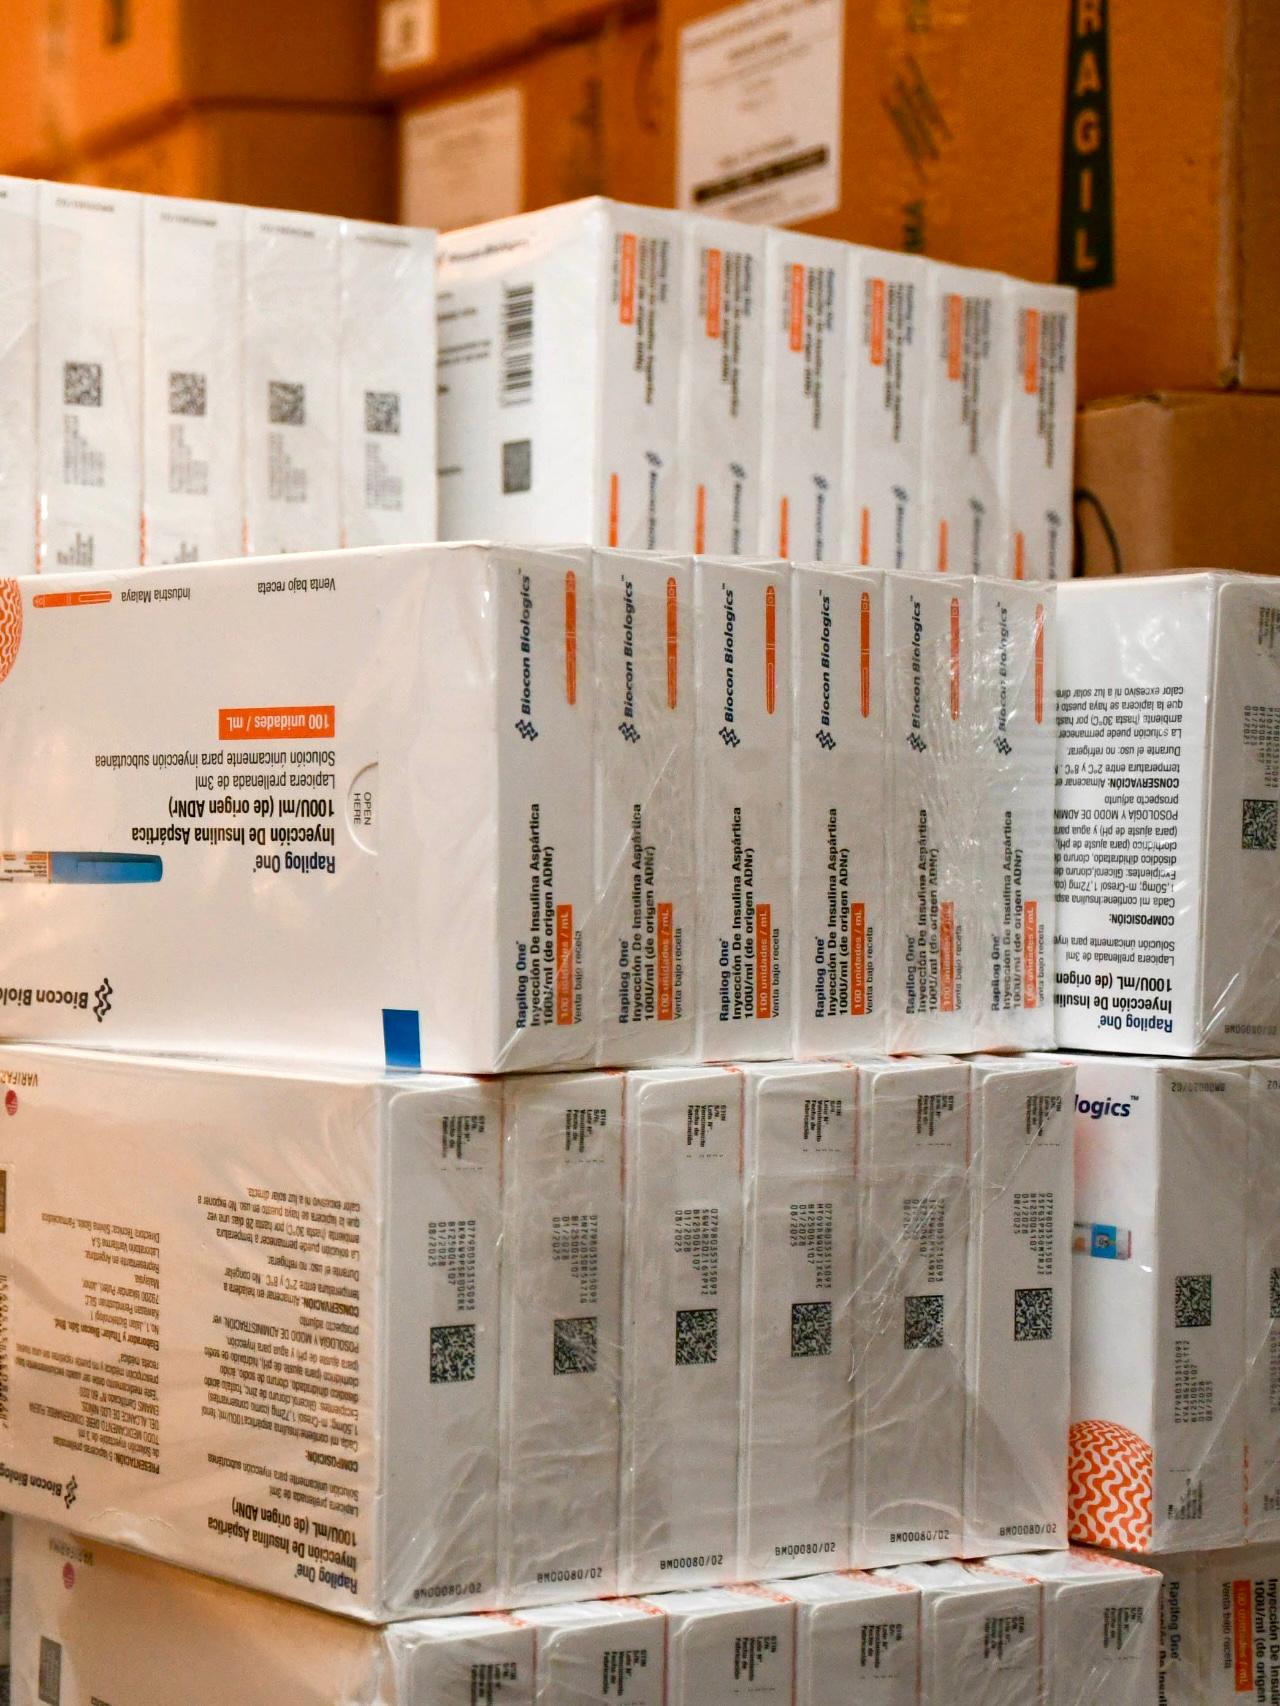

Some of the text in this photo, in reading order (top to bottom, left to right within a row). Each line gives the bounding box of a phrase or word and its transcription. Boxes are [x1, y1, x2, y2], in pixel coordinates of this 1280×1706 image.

[120, 587, 191, 603] Industria Malaya
[256, 576, 336, 595] Venta bajo receta
[723, 666, 734, 723] Biocon
[820, 671, 830, 726] Biocon
[225, 715, 243, 731] mL
[253, 713, 305, 731] unidades
[307, 713, 329, 729] 100
[94, 749, 336, 770] Solución únicamente para inyección subcutánea
[194, 771, 335, 791] Lapicera prellenada de 3ml
[167, 794, 335, 818] 100U/ml (de origen ADNr)
[353, 793, 361, 825] HERE
[364, 791, 372, 826] OPEN
[131, 822, 335, 846] Inyección De Insulina Aspártica
[284, 851, 335, 874] Rapilog
[730, 806, 744, 1020] Inyección De Insulina Aspártica
[758, 910, 767, 927] mL
[826, 807, 839, 1016] Inyección De Insulina Aspártica
[853, 909, 862, 926] mL
[1108, 912, 1175, 926] COMPOSICIÓN:
[743, 847, 755, 1019] 100U/ml (de origen ADNr)
[838, 847, 850, 1015] 100U/ml (de origen ADNr)
[1070, 935, 1175, 952] Solución únicamente para
[759, 937, 768, 989] unidades
[853, 935, 862, 986] unidades
[1065, 950, 1175, 966] Lapicera prellenada de 3ml
[770, 927, 781, 1018] Venta bajo receta
[864, 926, 874, 1015] Venta bajo receta
[814, 967, 827, 1018] Rapilog
[1054, 971, 1172, 993] 100U/mL (de origen
[35, 988, 89, 1010] Biocon
[718, 969, 731, 1021] Rapilog
[759, 991, 768, 1012] 100
[853, 988, 862, 1008] 100
[1092, 995, 1109, 1011] De
[1111, 995, 1172, 1014] Inyección
[1125, 1012, 1173, 1033] Rapilog
